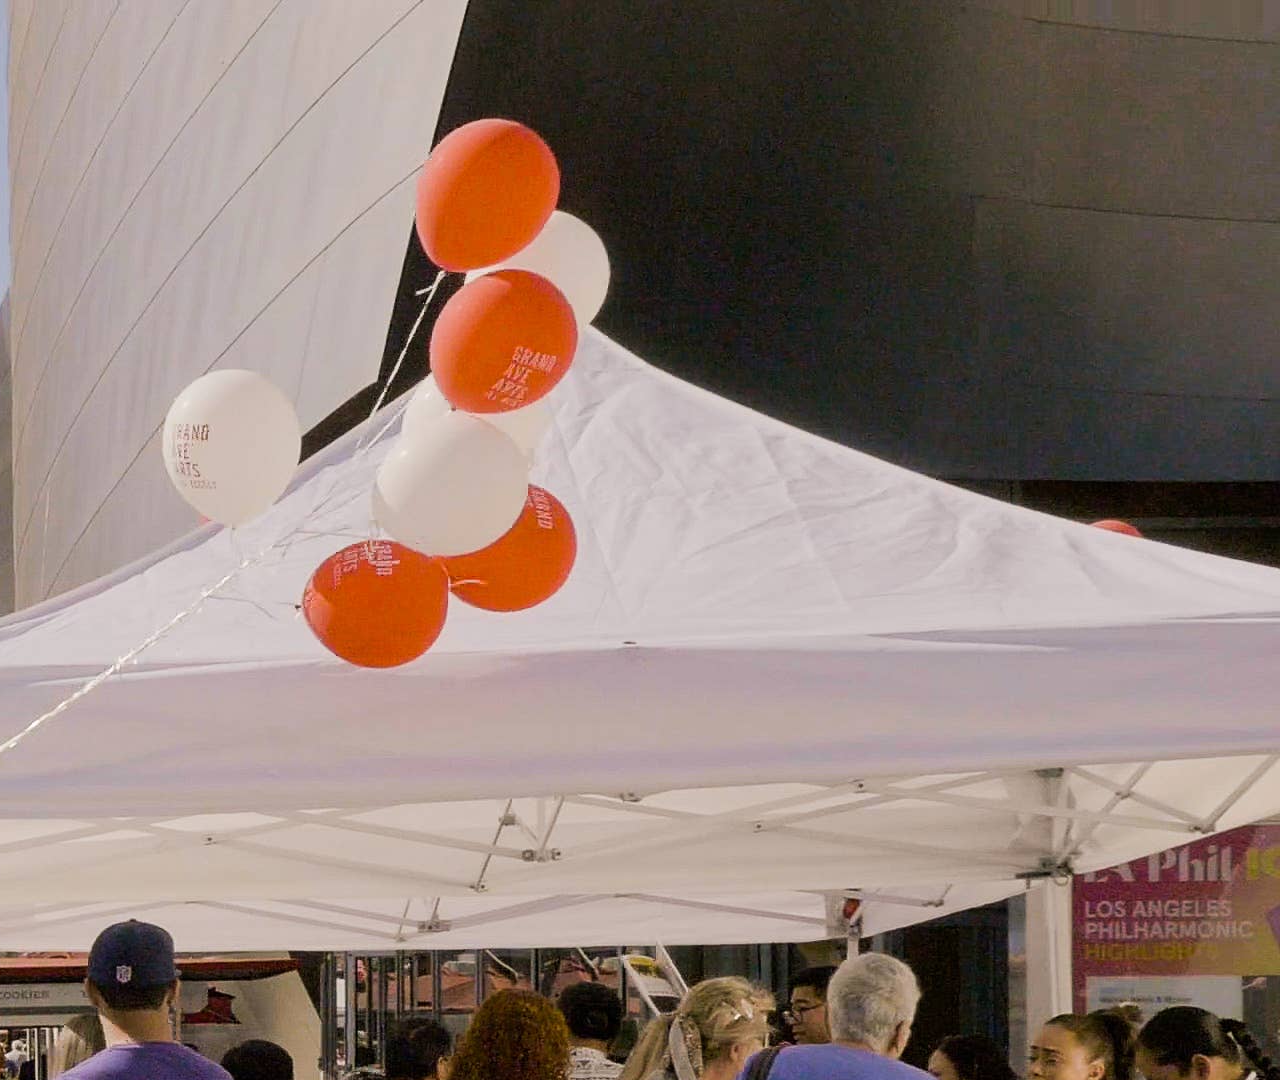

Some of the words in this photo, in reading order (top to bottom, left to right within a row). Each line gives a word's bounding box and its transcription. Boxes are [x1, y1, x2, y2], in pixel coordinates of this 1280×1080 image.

[1084, 900, 1126, 918] LOS
[1132, 900, 1232, 918] ANGELES
[1084, 920, 1254, 940] PHILHARMONIC
